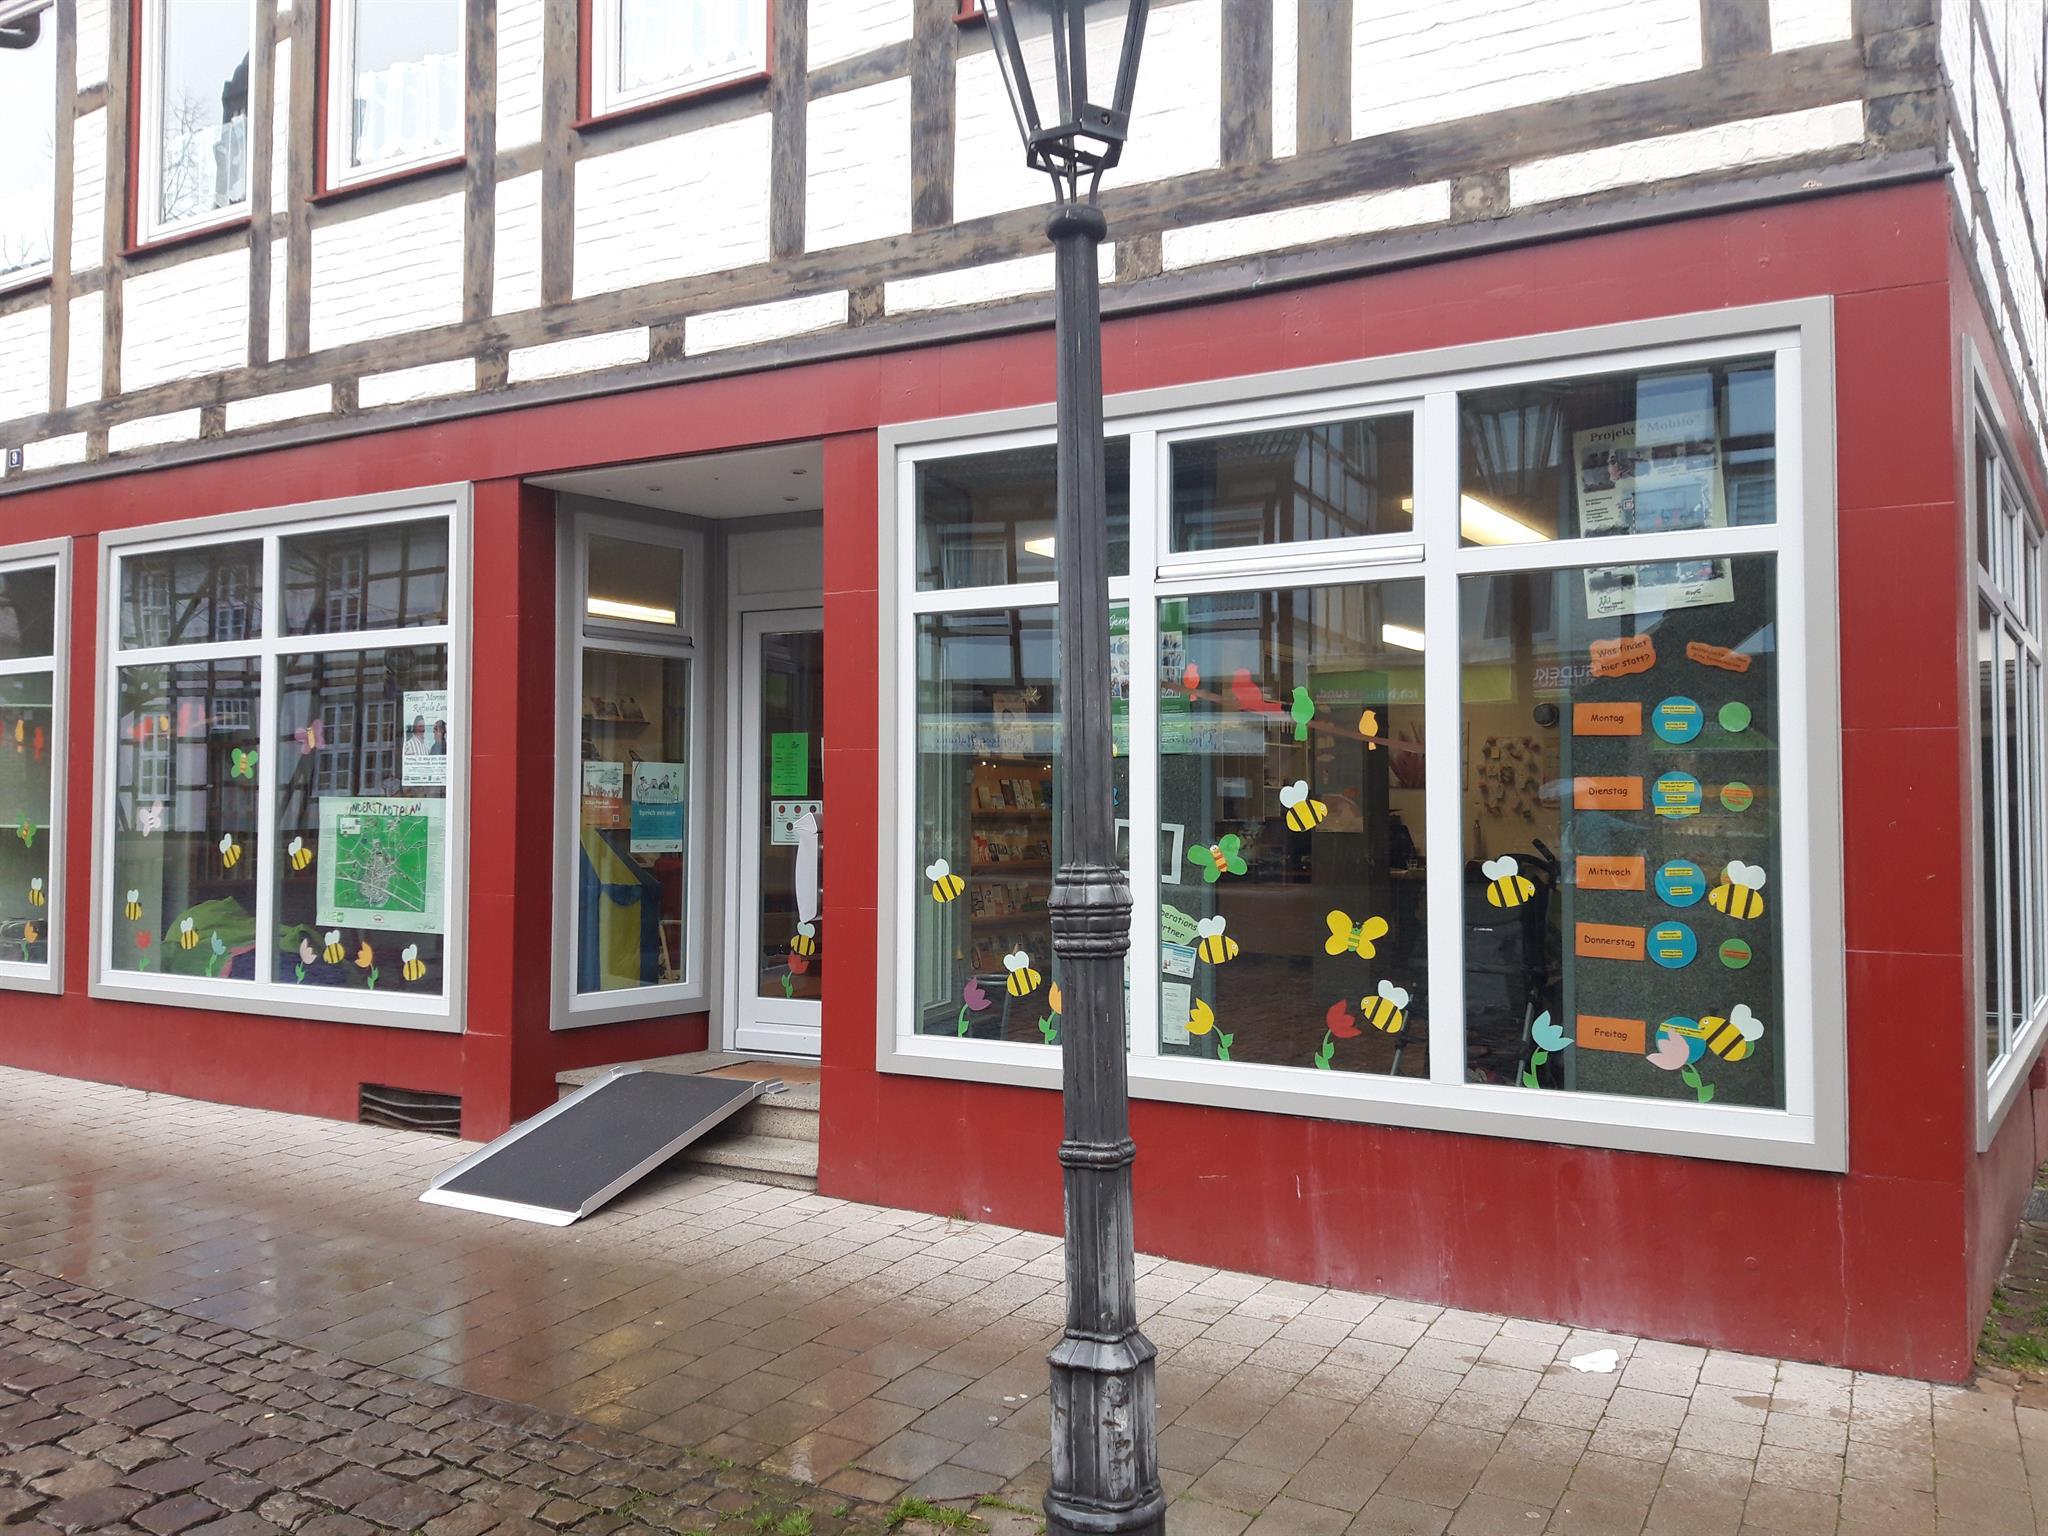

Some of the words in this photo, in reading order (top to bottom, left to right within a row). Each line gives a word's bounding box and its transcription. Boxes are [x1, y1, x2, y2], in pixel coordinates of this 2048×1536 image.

[1589, 427, 1636, 442] Projekt
[11, 452, 18, 464] 9
[1598, 647, 1617, 657] Was
[1619, 640, 1647, 653] findet
[1600, 662, 1620, 672] hier
[1621, 654, 1650, 667] statt?
[1590, 714, 1624, 724] Montag
[1588, 786, 1628, 796] Dienstag
[1588, 867, 1631, 876] Mittwoch
[1161, 925, 1185, 939] rtner
[1584, 935, 1636, 948] Donnerstag
[1594, 1027, 1628, 1041] Freitag
